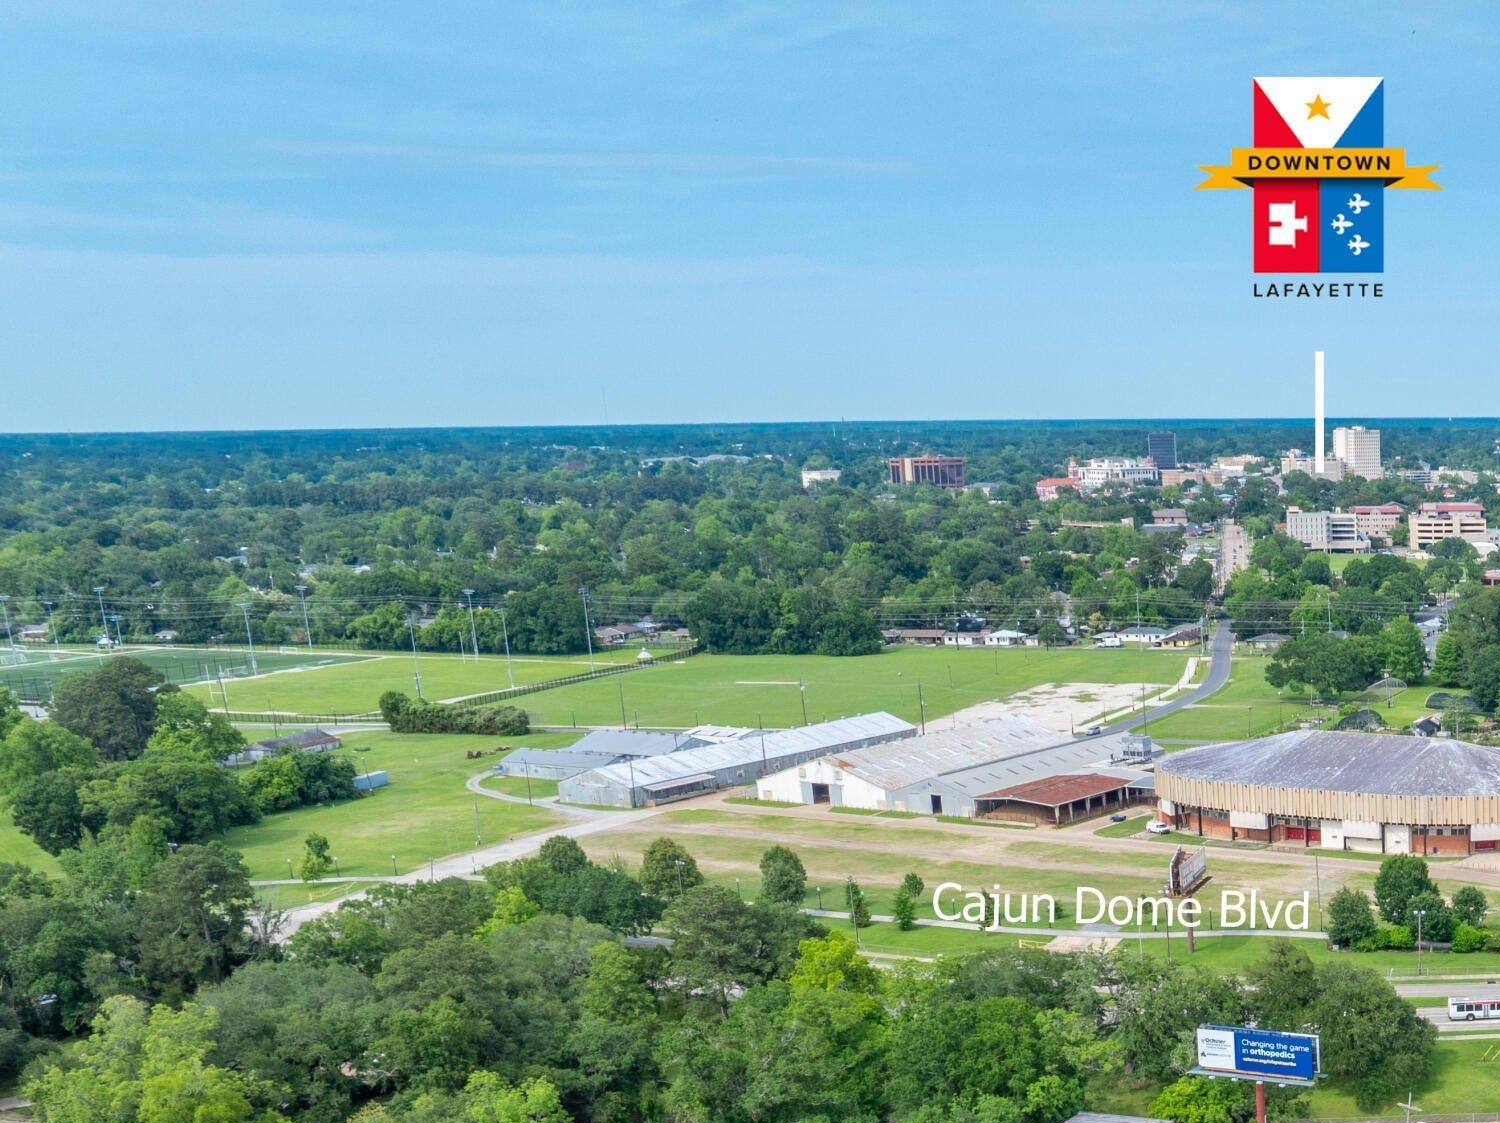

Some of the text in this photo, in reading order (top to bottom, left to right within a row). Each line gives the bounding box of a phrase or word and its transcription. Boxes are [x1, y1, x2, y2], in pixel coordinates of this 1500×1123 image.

[1241, 1038, 1275, 1050] Changing
[1276, 1042, 1287, 1051] the
[1289, 1044, 1310, 1053] game
[1250, 1048, 1295, 1059] orthopedics
